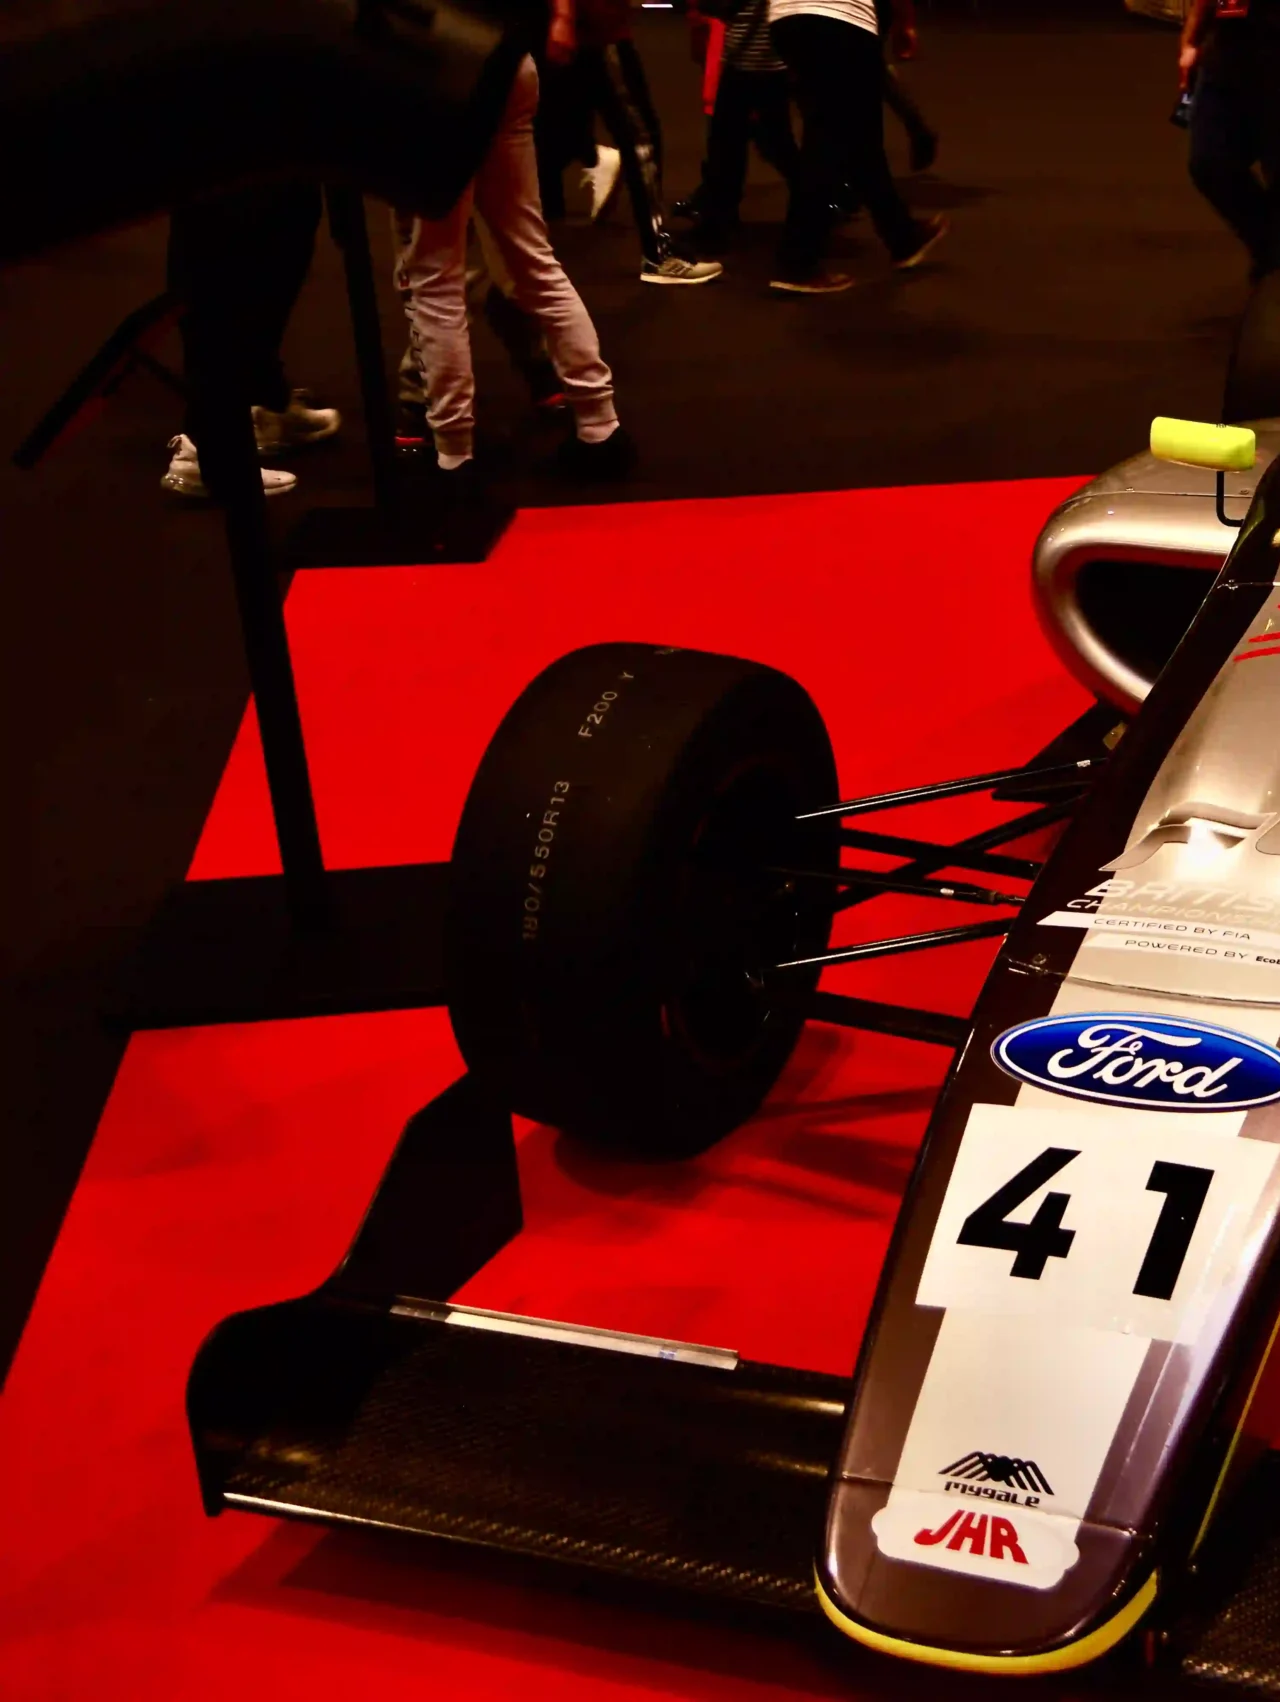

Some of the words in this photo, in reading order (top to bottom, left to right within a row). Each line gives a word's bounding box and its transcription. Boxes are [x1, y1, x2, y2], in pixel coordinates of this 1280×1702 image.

[522, 779, 571, 941] 180/550R13
[577, 690, 618, 739] F200
[1093, 918, 1189, 933] CERTIFIED
[1193, 926, 1219, 936] BY
[1221, 930, 1252, 941] FIA
[1123, 938, 1219, 957] POWERED
[1223, 950, 1250, 960] BY
[1046, 1023, 1244, 1099] Ford
[955, 1145, 1216, 1301] 41
[912, 1508, 1030, 1566] JHR
